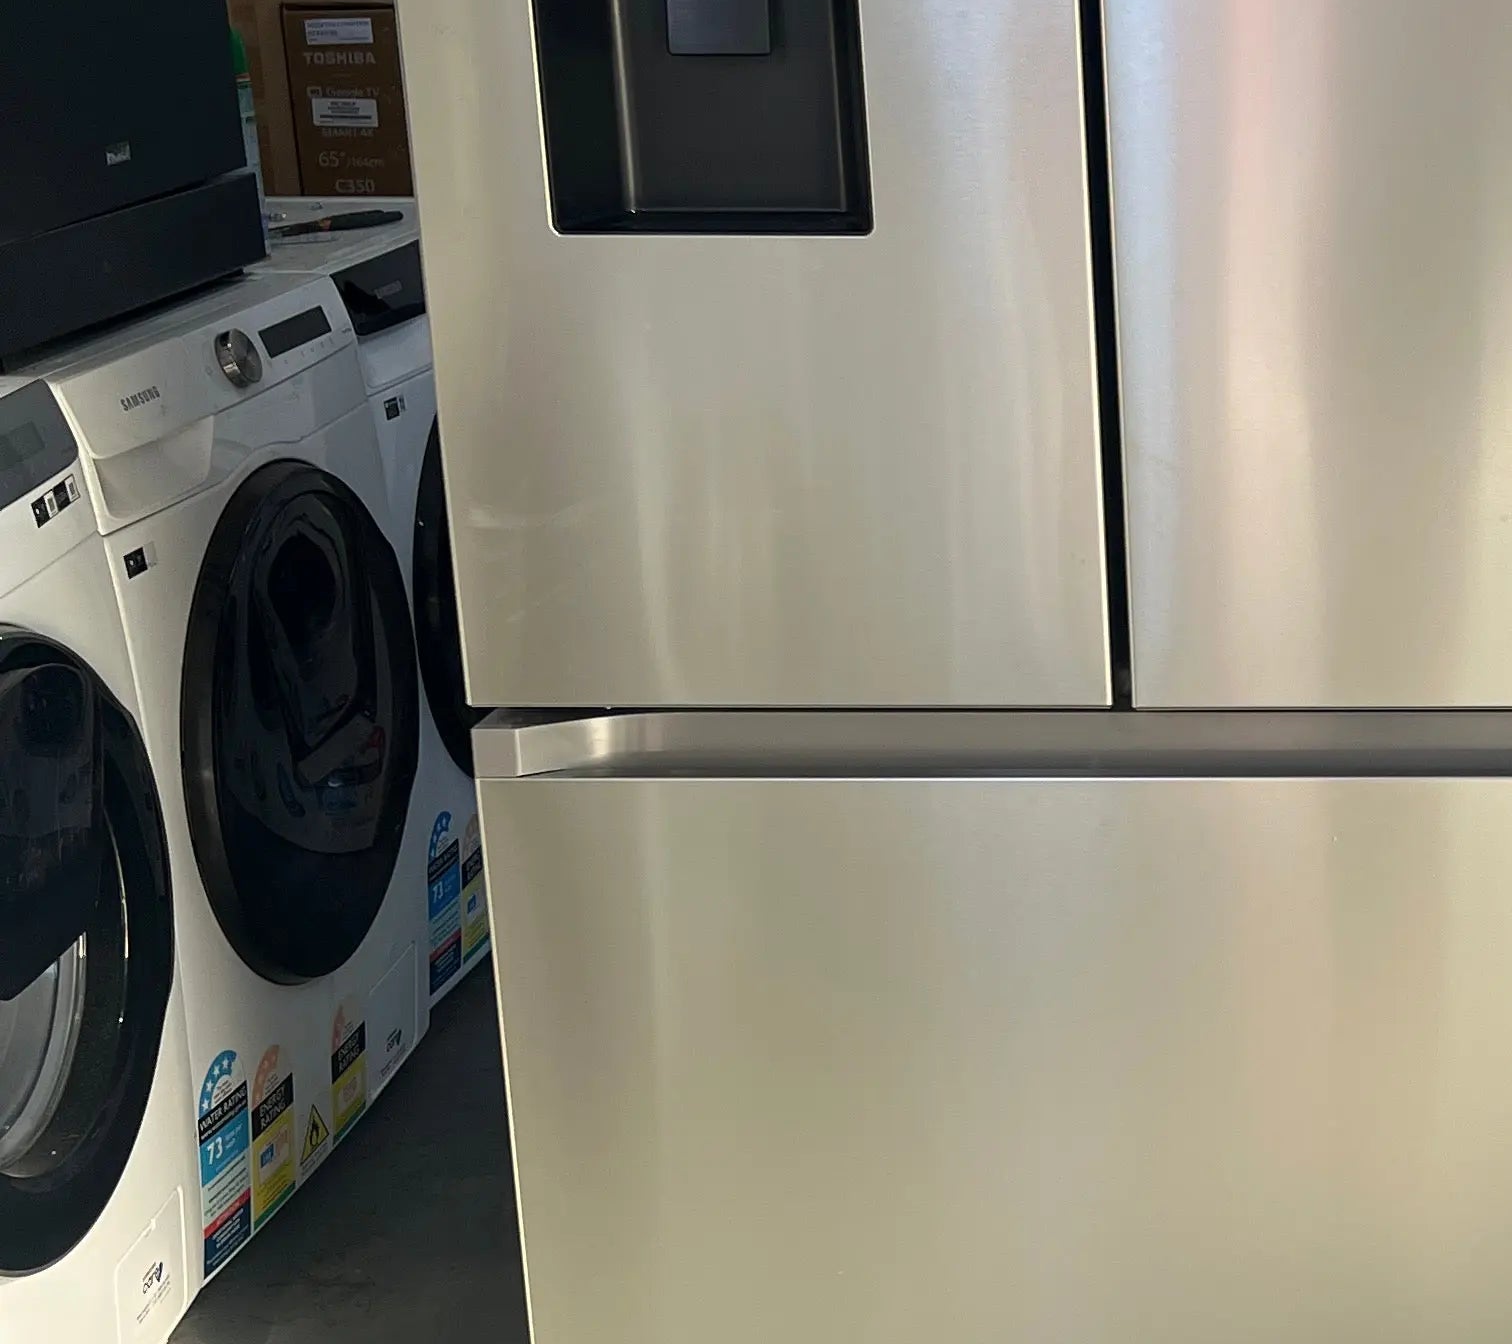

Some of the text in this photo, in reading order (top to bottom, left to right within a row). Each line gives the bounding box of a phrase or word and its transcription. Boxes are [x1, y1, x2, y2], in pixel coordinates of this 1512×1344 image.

[303, 51, 377, 66] TOSHIBA
[120, 385, 161, 412] SAMSUNG
[206, 1136, 224, 1165] 73
